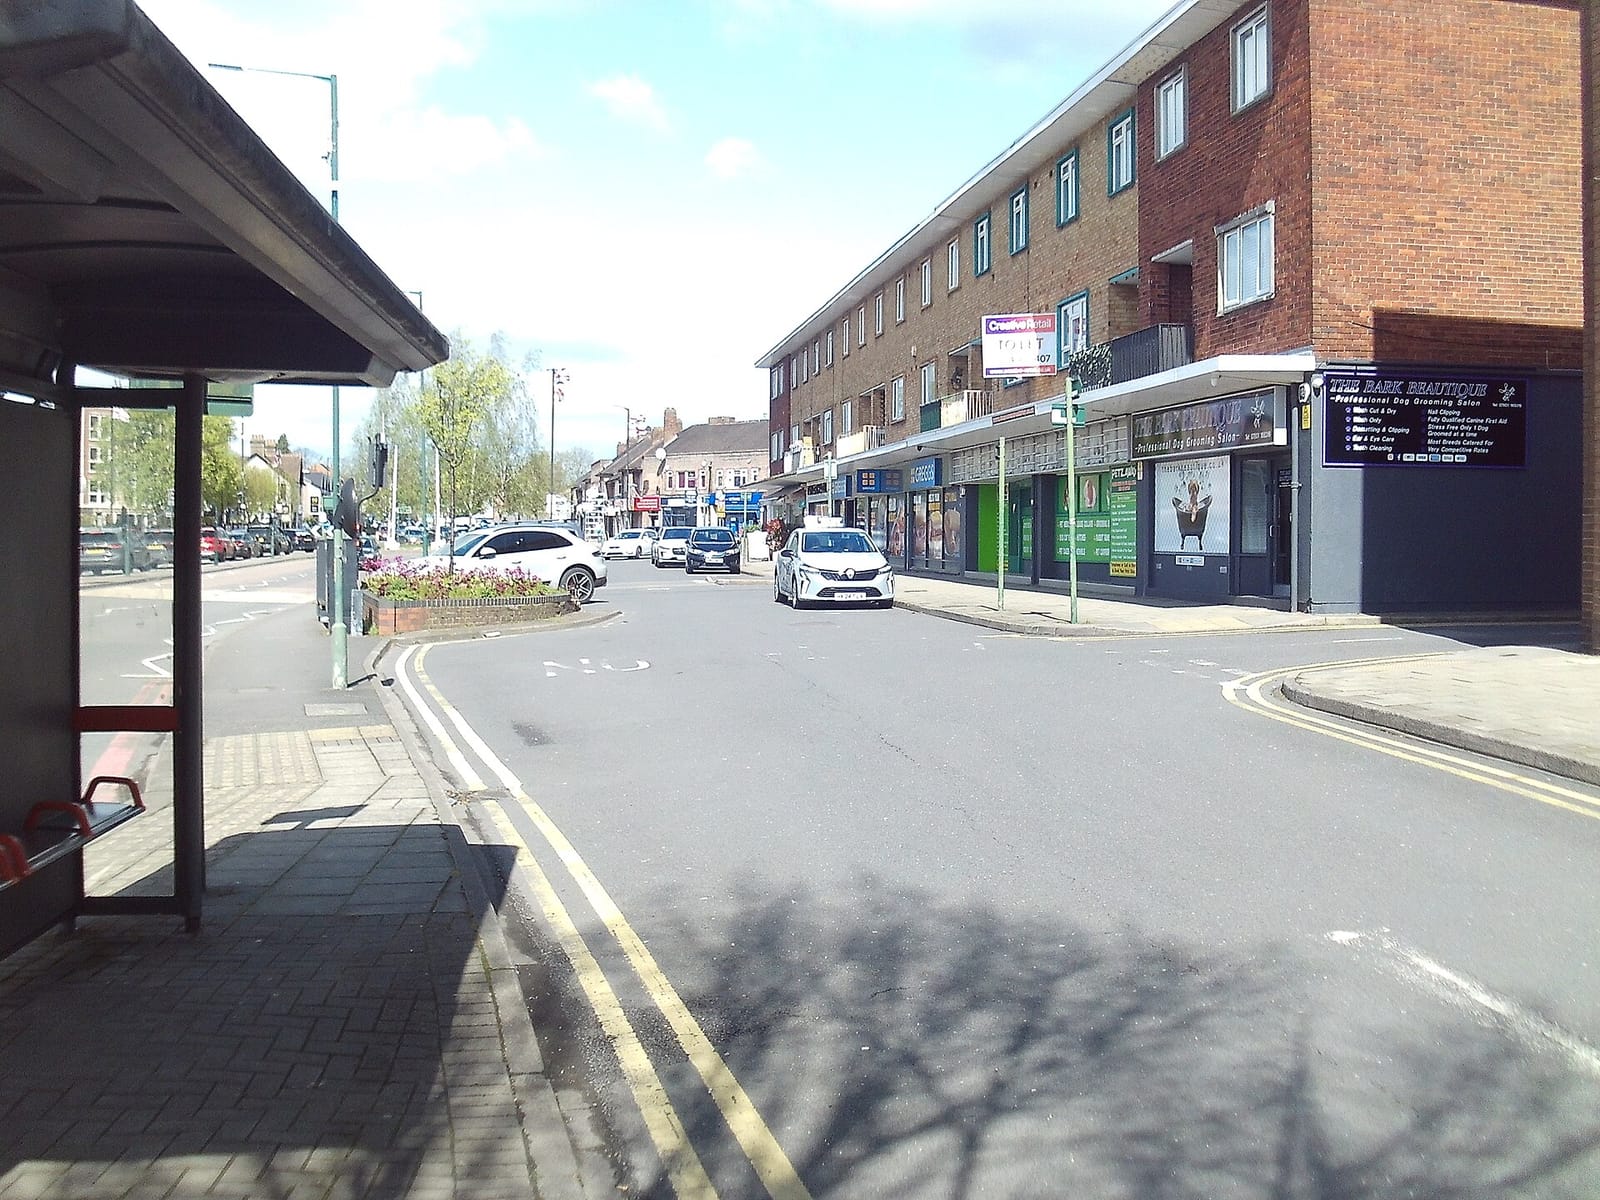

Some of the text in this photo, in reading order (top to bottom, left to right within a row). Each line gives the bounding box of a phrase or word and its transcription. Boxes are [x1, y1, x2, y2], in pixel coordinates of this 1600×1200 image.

[1027, 319, 1052, 329] Retail
[1329, 379, 1488, 399] THE BARK BEAUTIQUE
[1393, 398, 1410, 406] Dog
[1413, 398, 1453, 407] Grooming
[1457, 399, 1481, 407] Salon
[1172, 438, 1184, 450] Dog
[1186, 434, 1216, 447] Grooming
